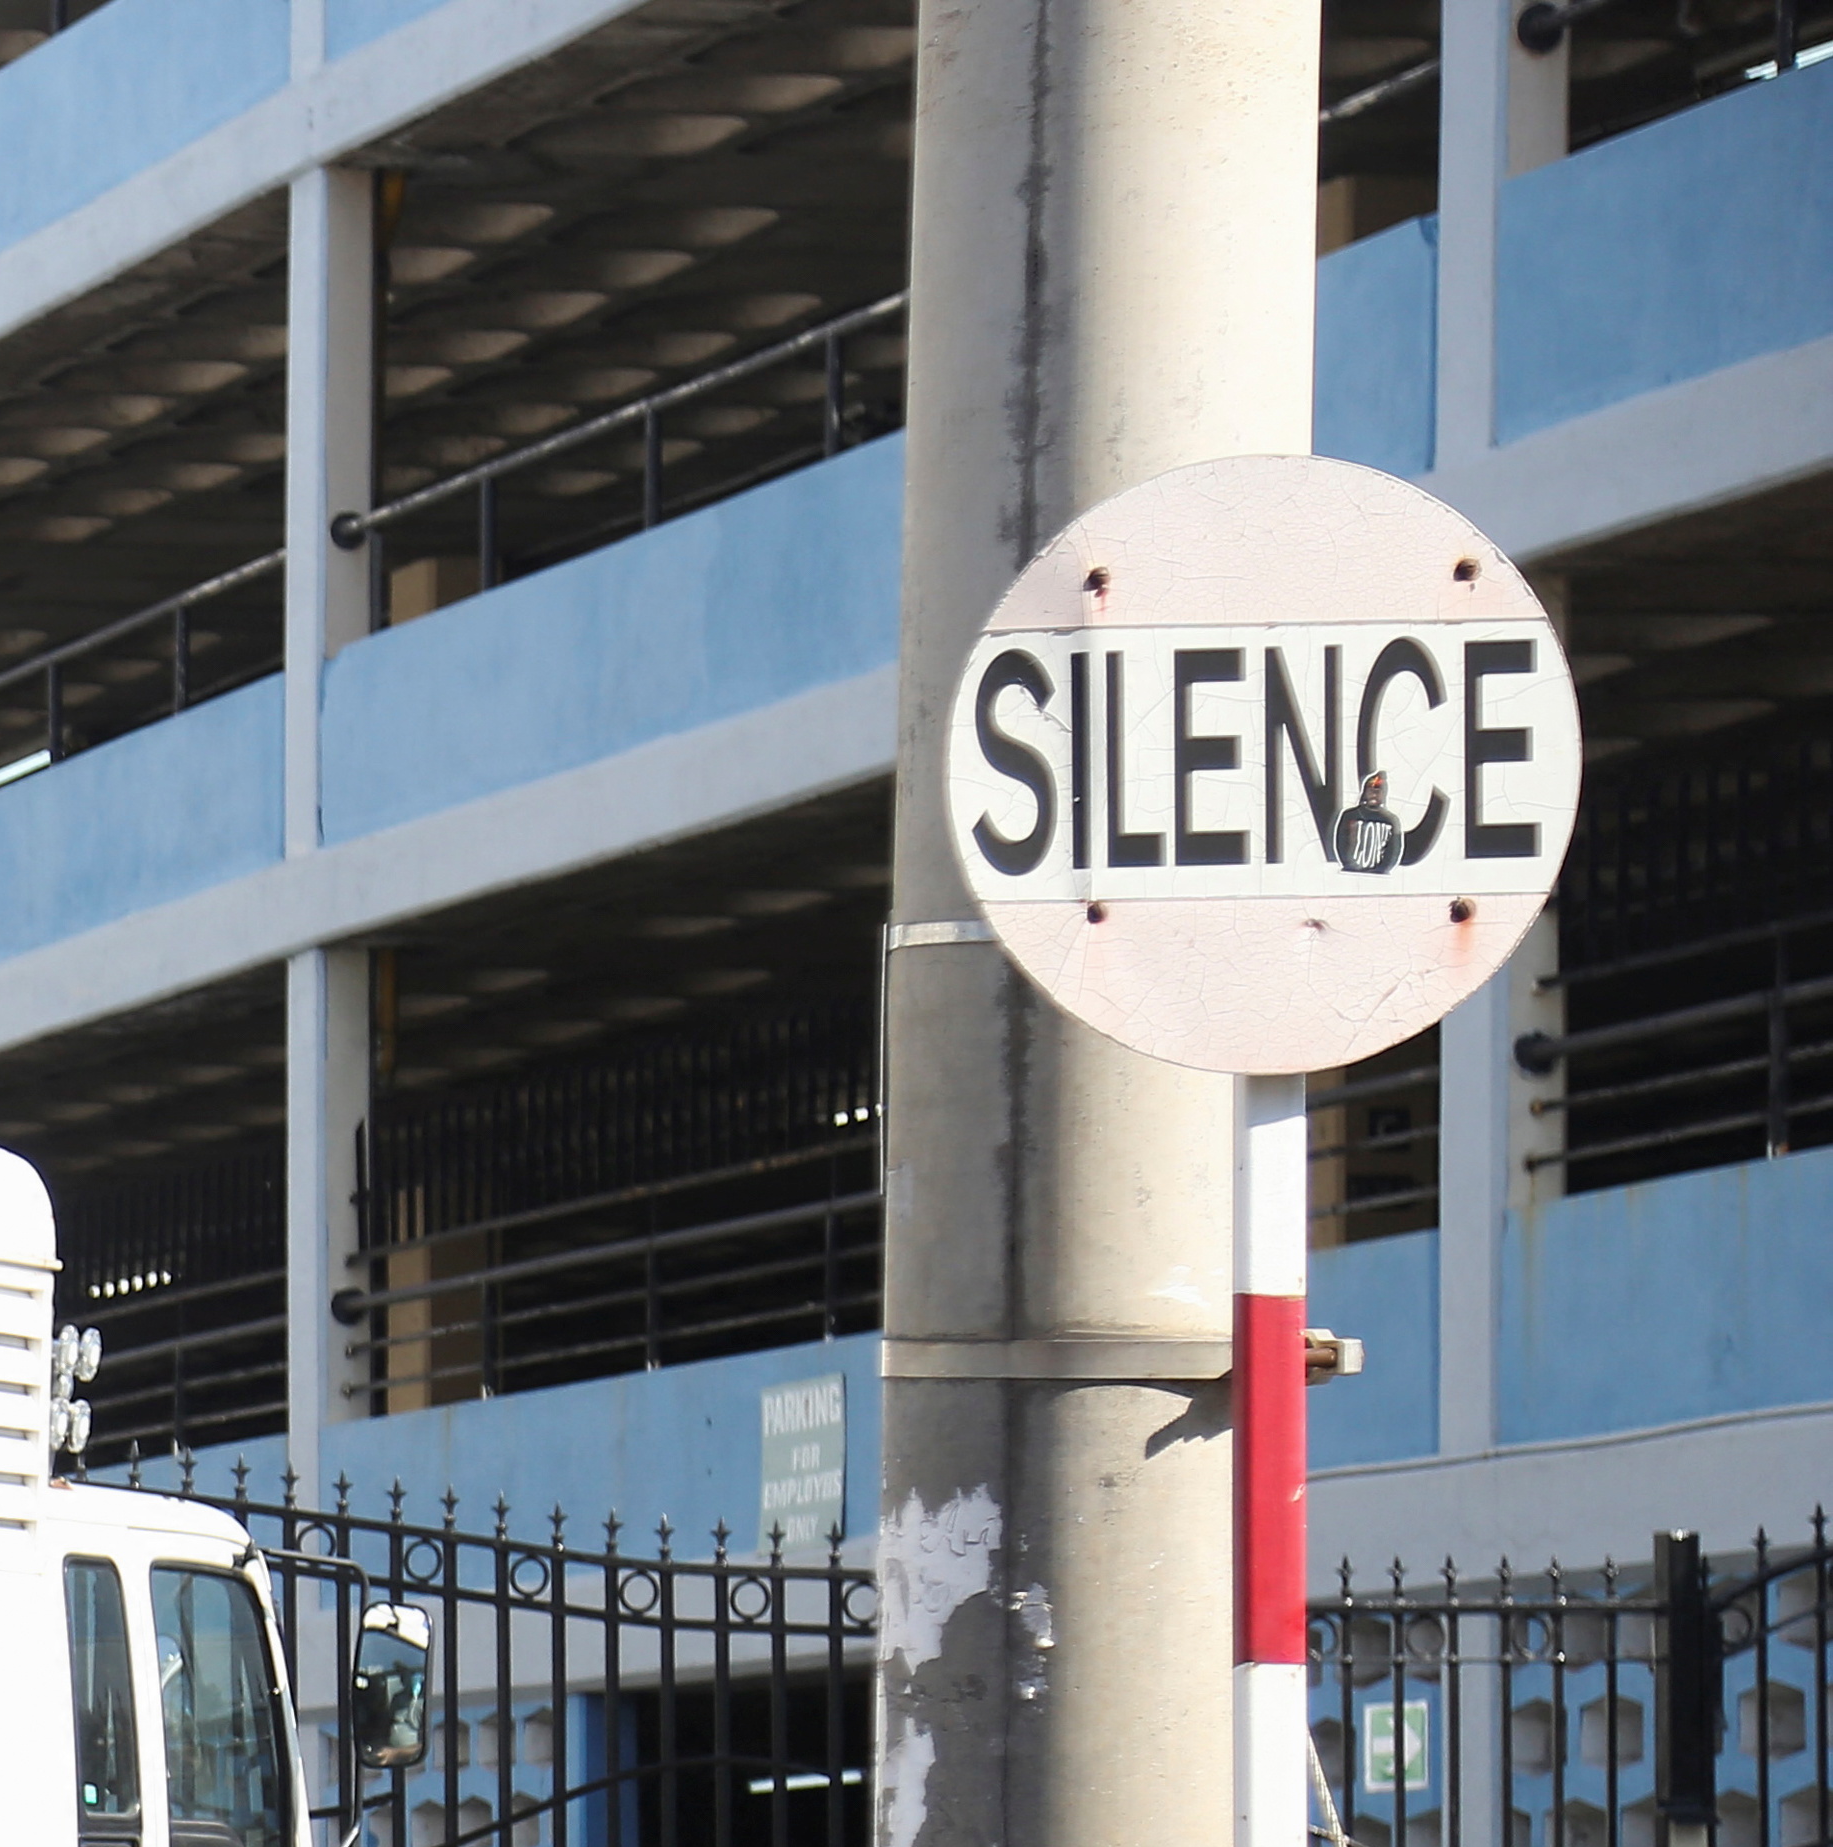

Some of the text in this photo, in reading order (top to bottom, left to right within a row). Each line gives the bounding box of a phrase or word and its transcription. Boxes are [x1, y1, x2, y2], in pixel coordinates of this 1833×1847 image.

[972, 636, 1541, 876] SILENCE
[763, 1382, 842, 1437] PARKING
[791, 1444, 821, 1471] FOR
[786, 1513, 819, 1544] ONLY
